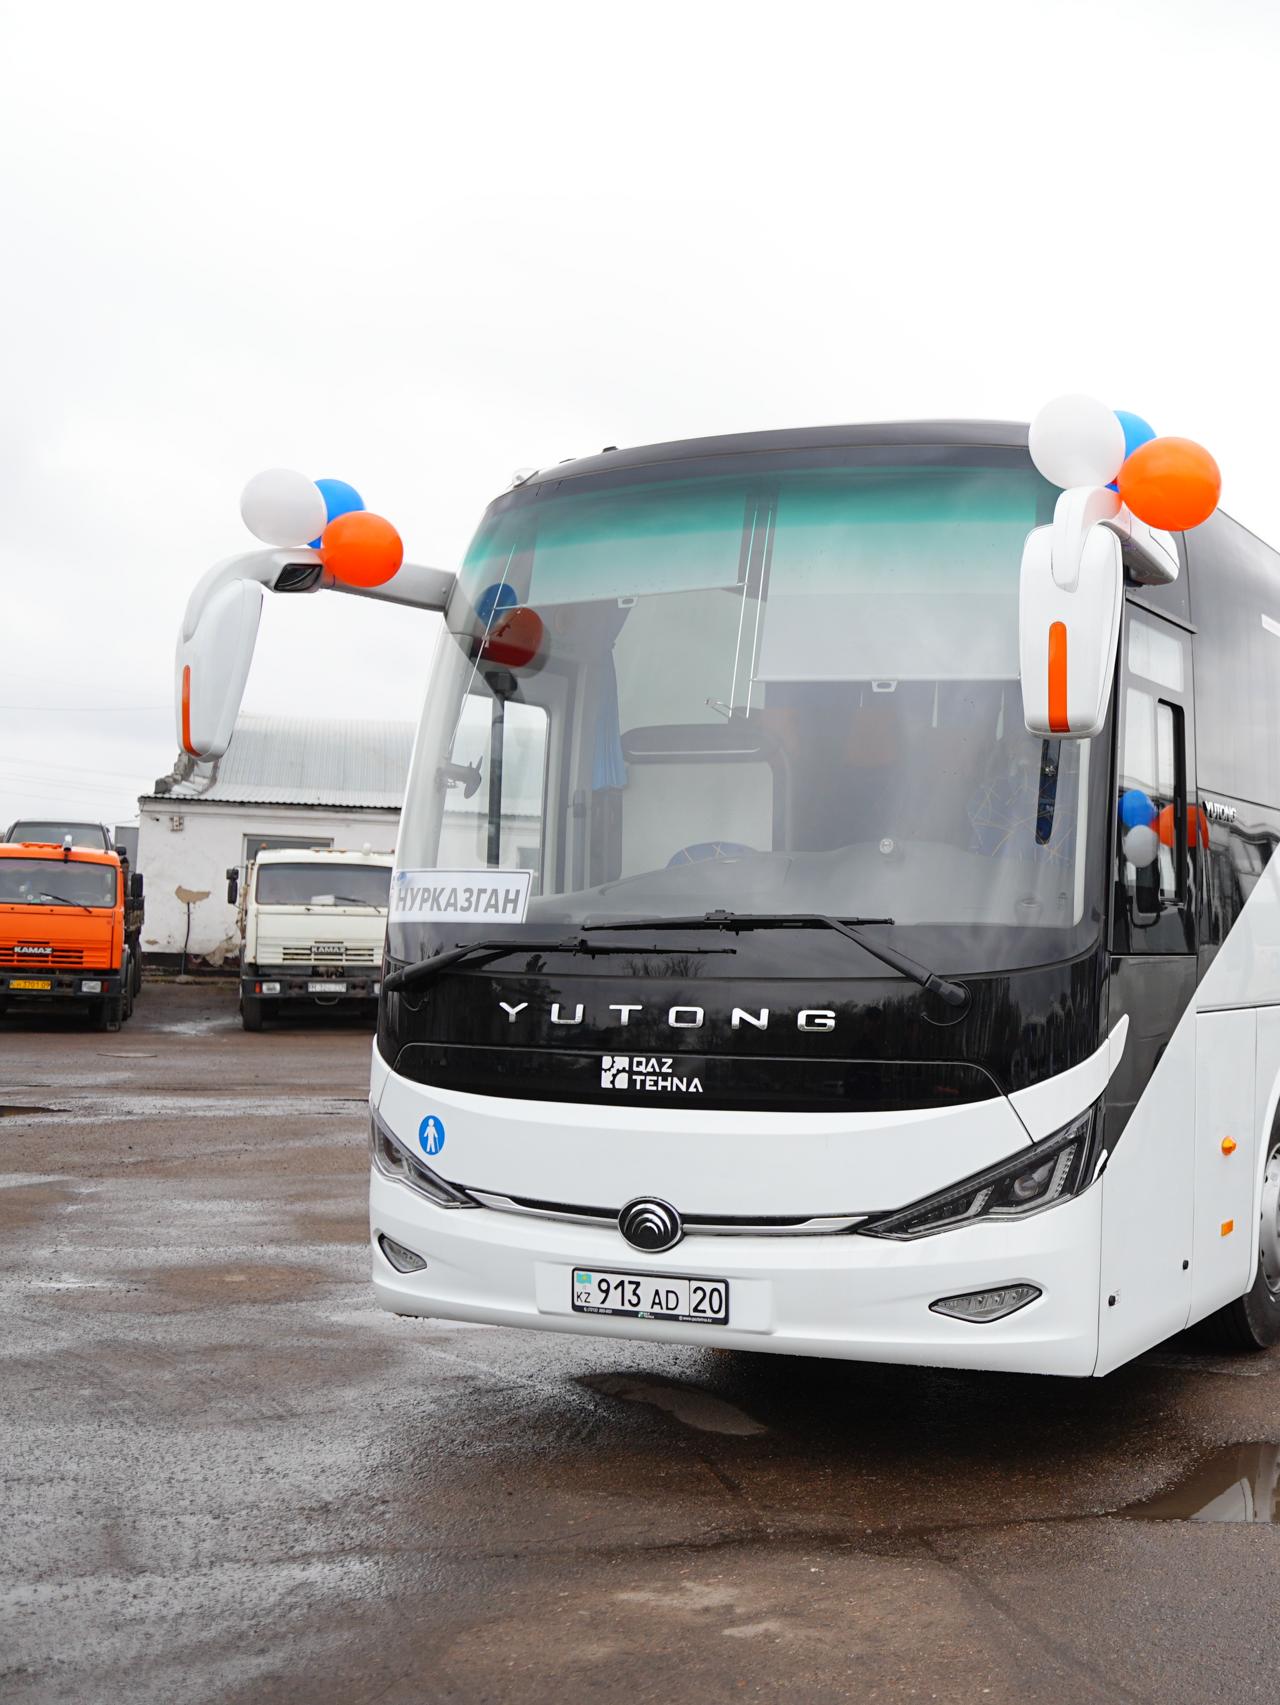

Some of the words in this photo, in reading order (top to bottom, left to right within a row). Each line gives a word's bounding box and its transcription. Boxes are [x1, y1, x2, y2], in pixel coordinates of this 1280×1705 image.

[1204, 800, 1237, 823] YUTONG
[395, 887, 521, 914] НУРКАЗГАН
[499, 1002, 836, 1032] YUTONG
[633, 1057, 673, 1074] QAZ
[633, 1076, 703, 1093] TEHNA
[576, 1291, 591, 1303] KZ
[597, 1278, 641, 1308] 913
[650, 1288, 680, 1311] AD
[692, 1286, 723, 1315] 20
